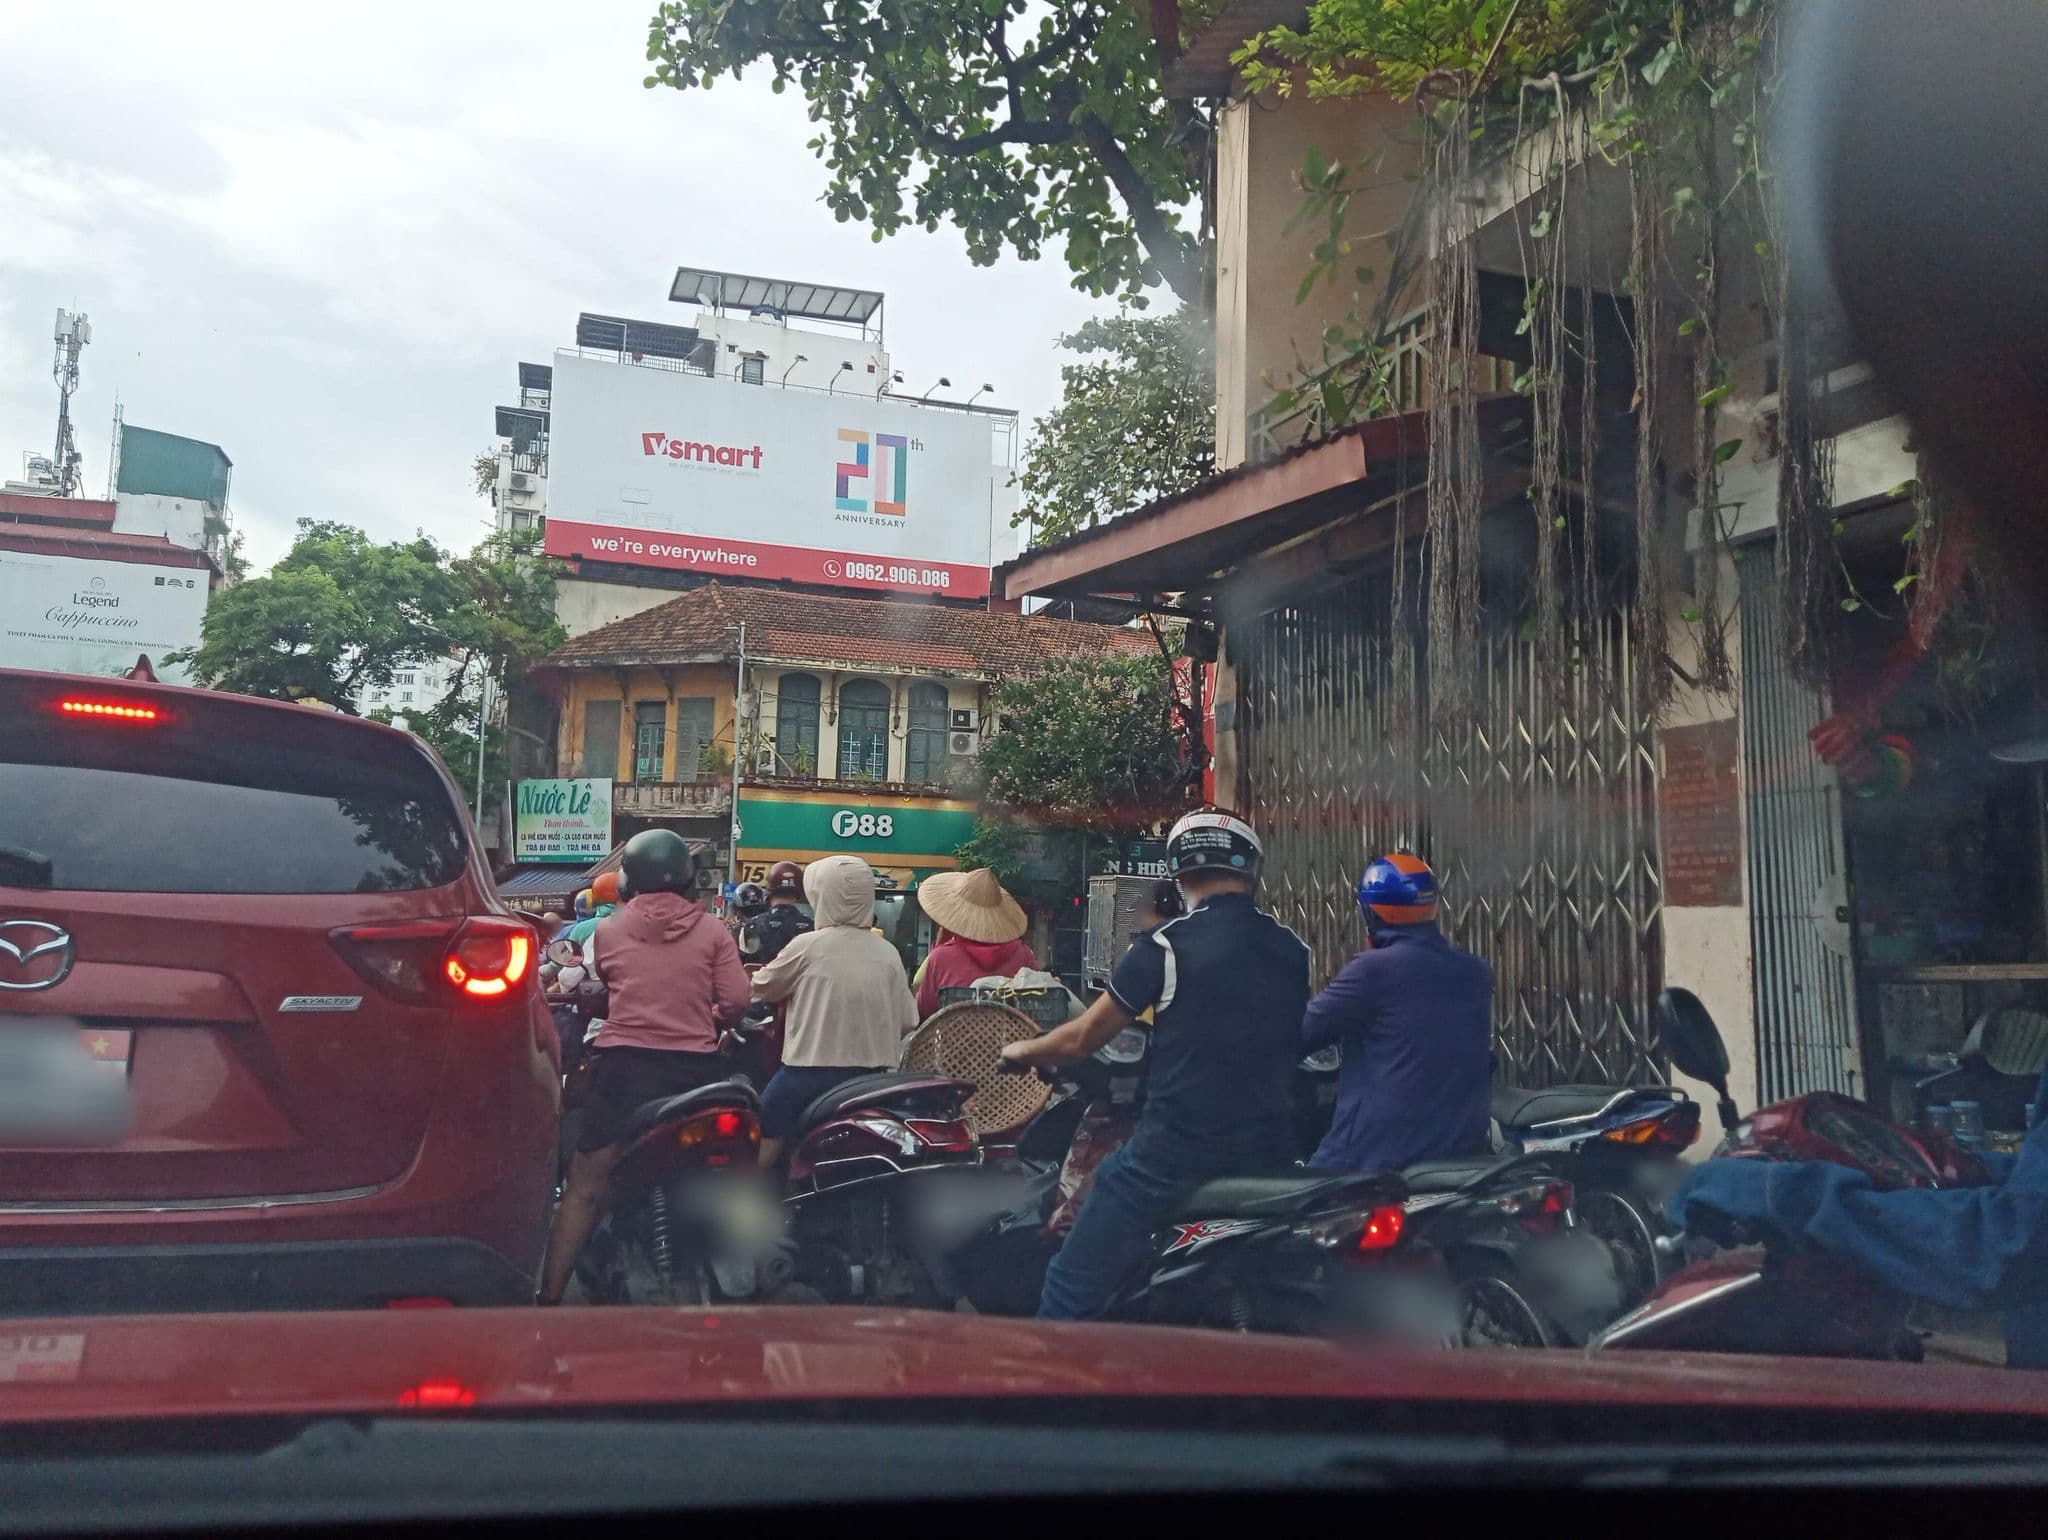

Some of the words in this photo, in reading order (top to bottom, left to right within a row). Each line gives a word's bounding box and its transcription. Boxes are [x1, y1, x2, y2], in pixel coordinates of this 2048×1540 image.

[835, 514, 906, 528] ANNIVERSARY
[649, 544, 758, 567] everywhere
[845, 561, 950, 588] 0962.906.086
[73, 593, 119, 608] Legend
[45, 606, 138, 629] Cappuccino
[520, 784, 565, 815] Nước
[569, 783, 592, 815] Lê
[832, 810, 893, 837] F88
